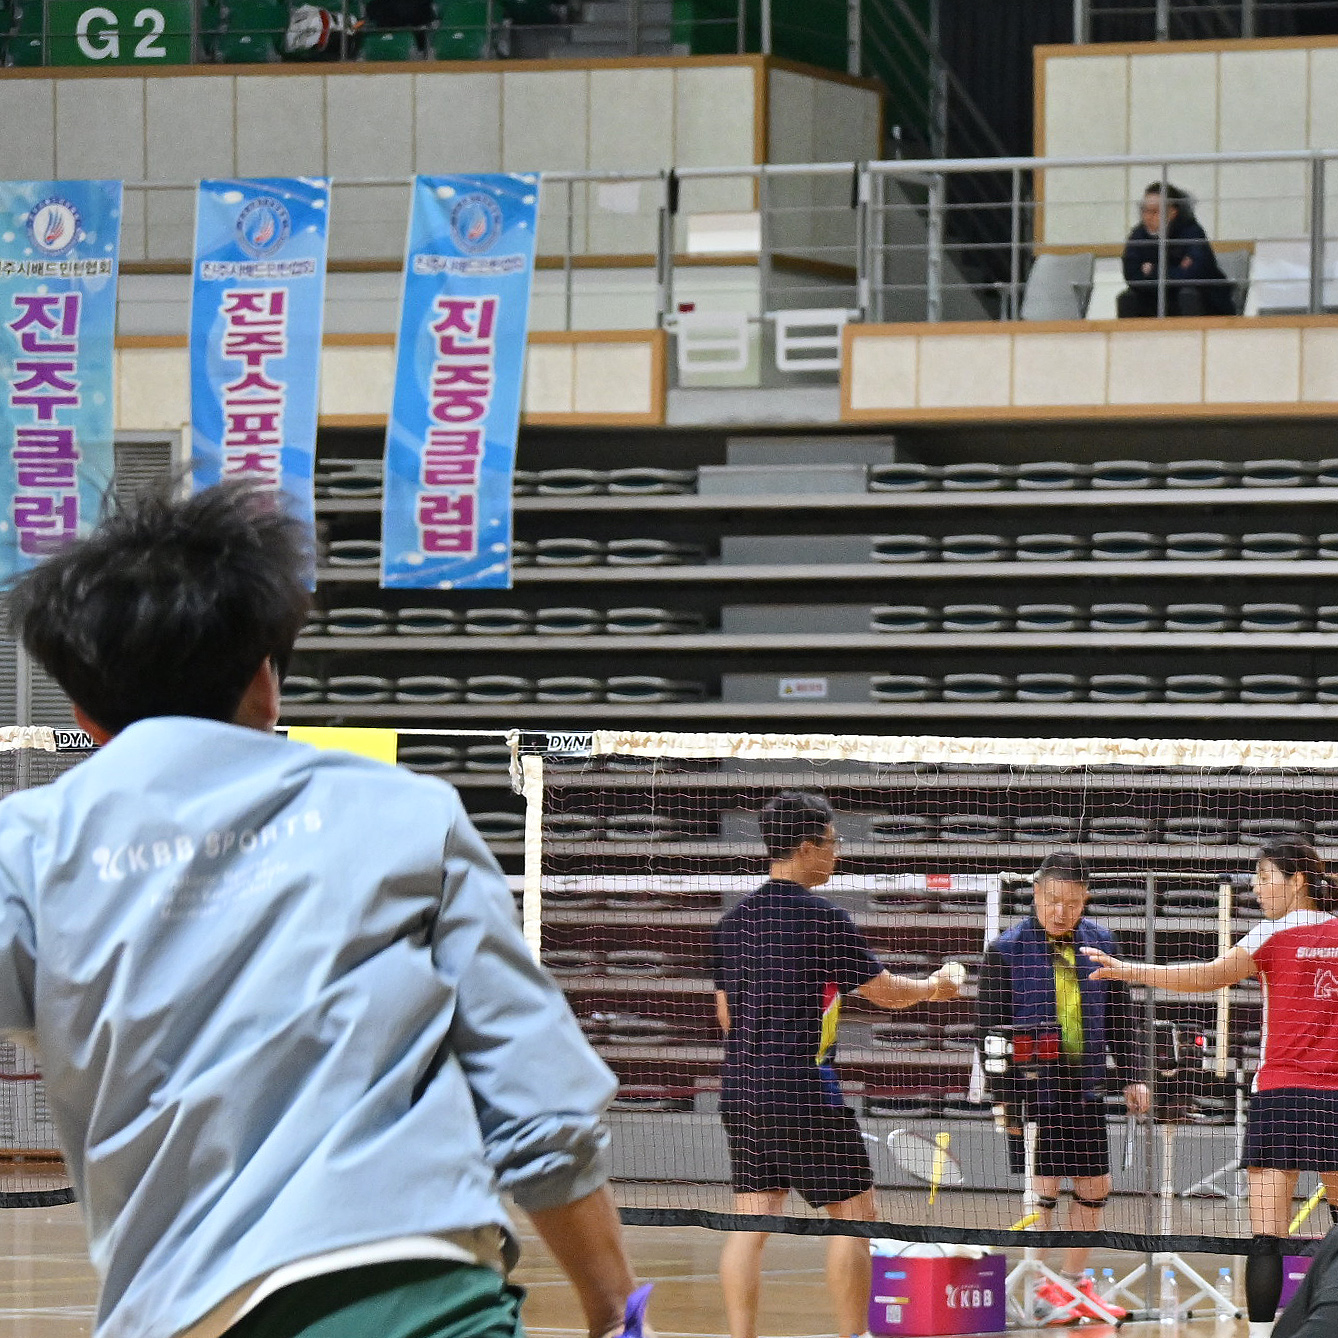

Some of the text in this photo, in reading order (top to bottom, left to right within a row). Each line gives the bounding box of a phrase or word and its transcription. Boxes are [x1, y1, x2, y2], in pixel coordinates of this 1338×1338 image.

[76, 6, 167, 60] G2
[9, 294, 80, 555] 진주클럽
[418, 298, 497, 554] 진중클럽
[960, 1288, 993, 1309] KBB
